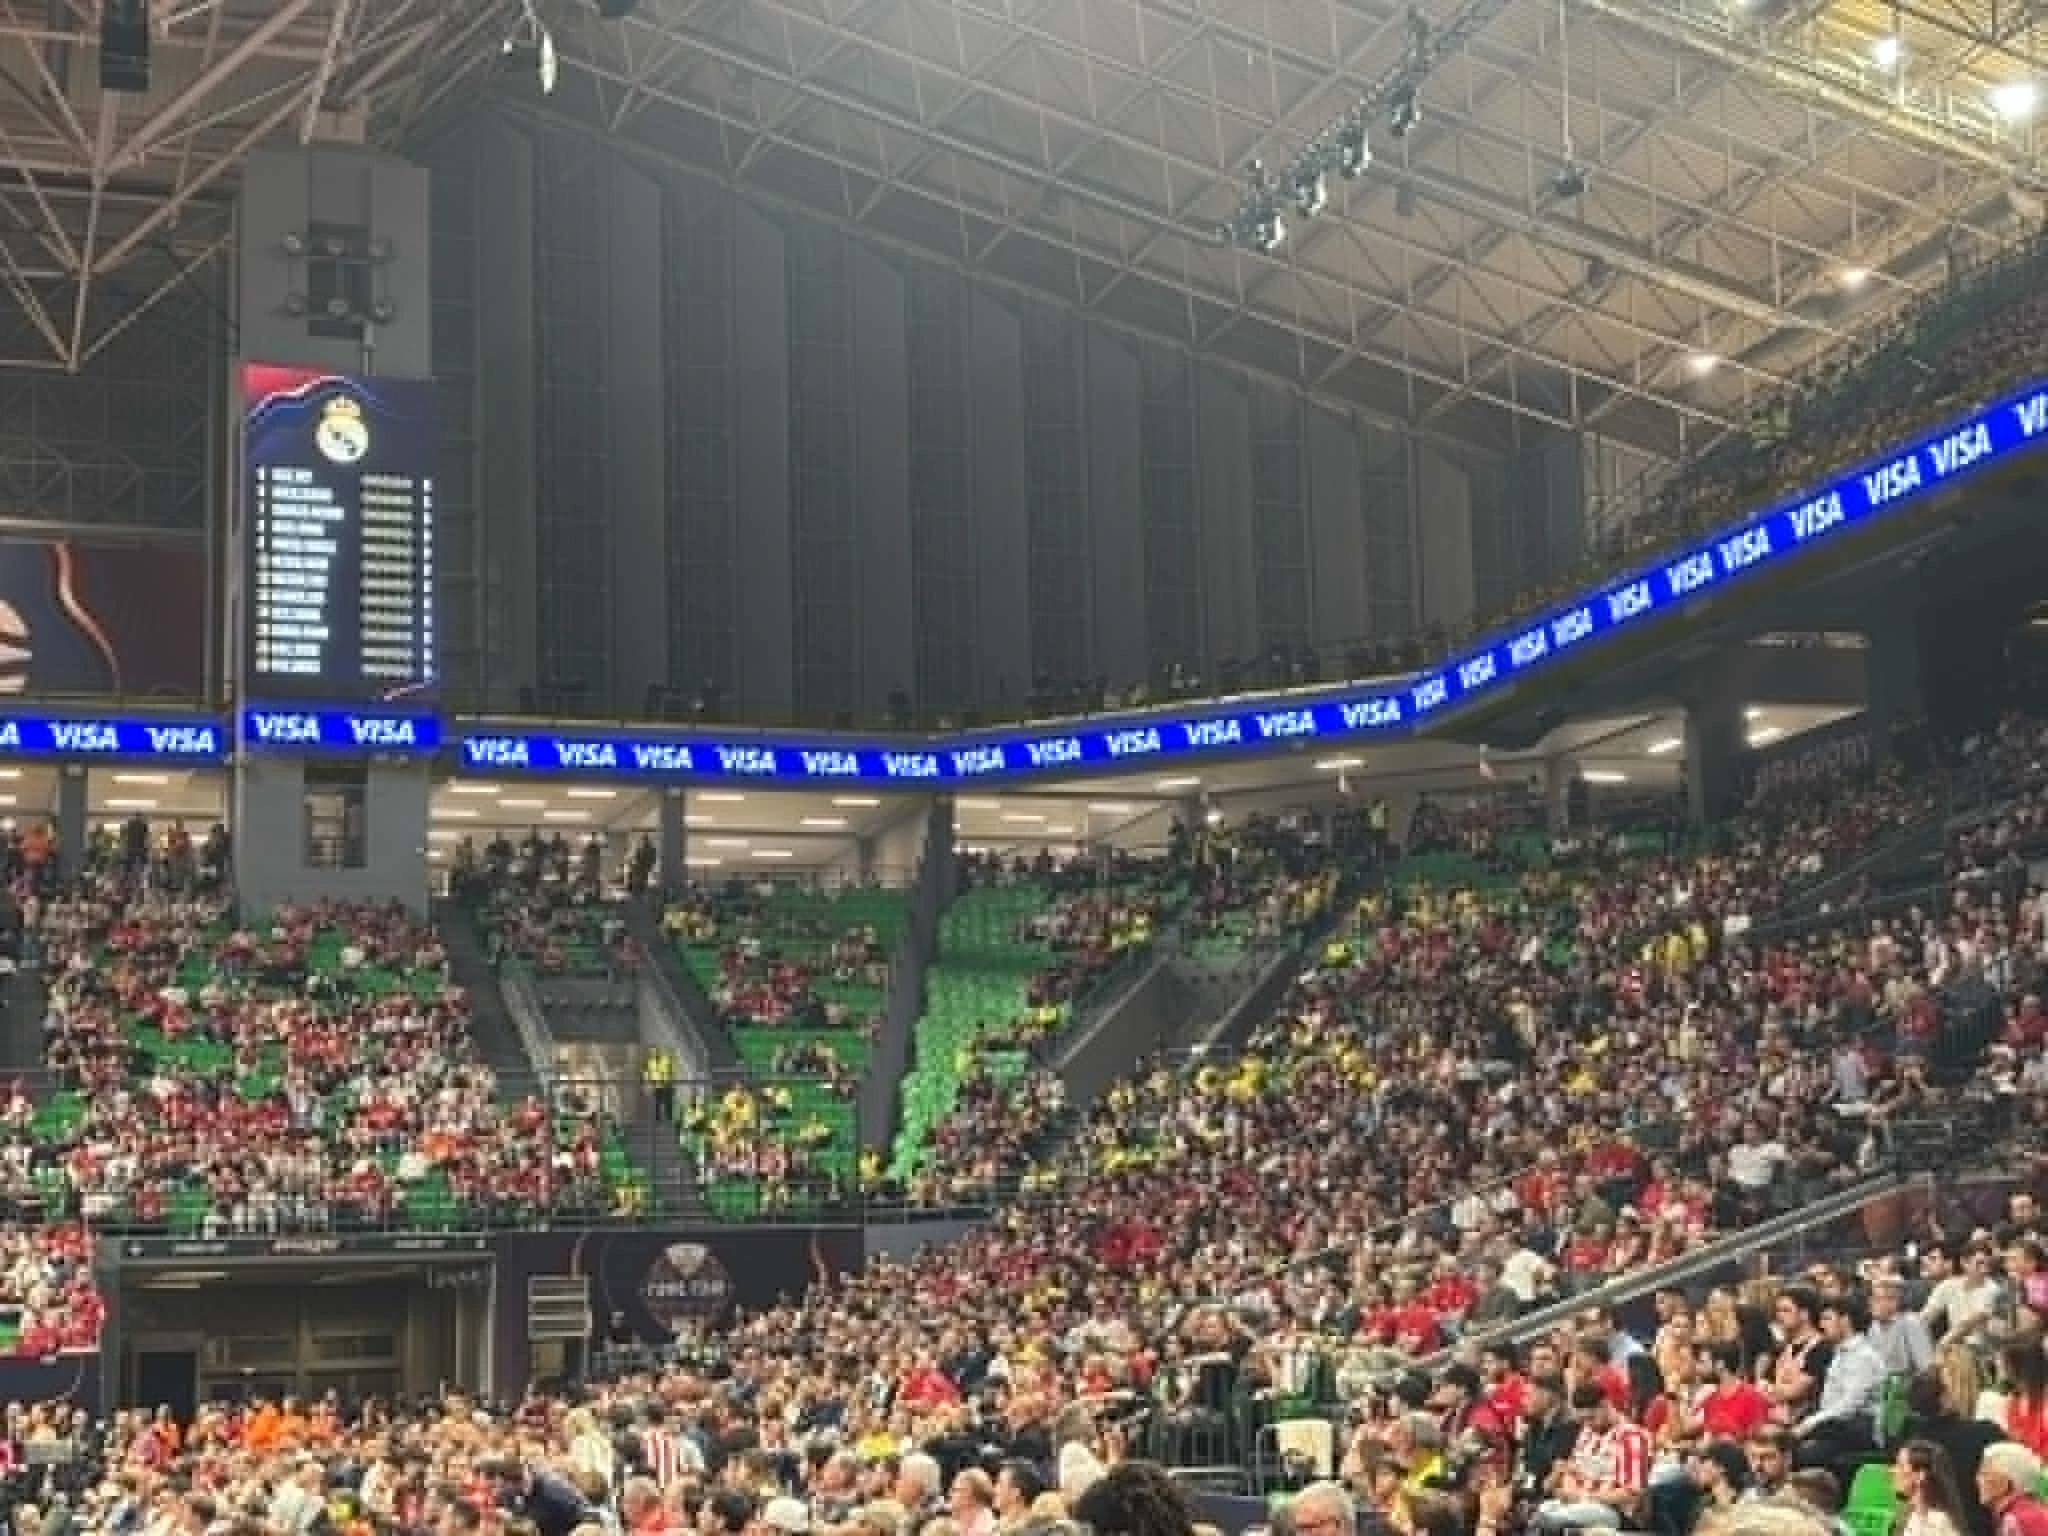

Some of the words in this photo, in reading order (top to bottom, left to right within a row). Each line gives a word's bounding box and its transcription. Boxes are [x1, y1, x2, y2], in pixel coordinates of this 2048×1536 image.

[1666, 552, 1713, 595] VISA
[1719, 524, 1771, 571] VISA
[1788, 490, 1844, 538] VISA
[1863, 455, 1921, 505] VISA
[1927, 423, 1993, 477] VISA
[2013, 391, 2048, 436] VI
[48, 723, 119, 752] VISA
[145, 727, 216, 753] VISA
[252, 714, 321, 742] VISA
[349, 719, 416, 745] VISA
[464, 738, 529, 763] VISA
[554, 742, 618, 767] VISA
[632, 744, 694, 769] VISA
[717, 747, 777, 772] VISA
[801, 751, 859, 775] VISA
[883, 754, 938, 777] VISA
[951, 747, 1005, 775] VISA
[1027, 737, 1081, 766] VISA
[1105, 728, 1161, 755] VISA
[1183, 719, 1241, 746] VISA
[1256, 710, 1315, 737] VISA
[1342, 697, 1401, 729] VISA
